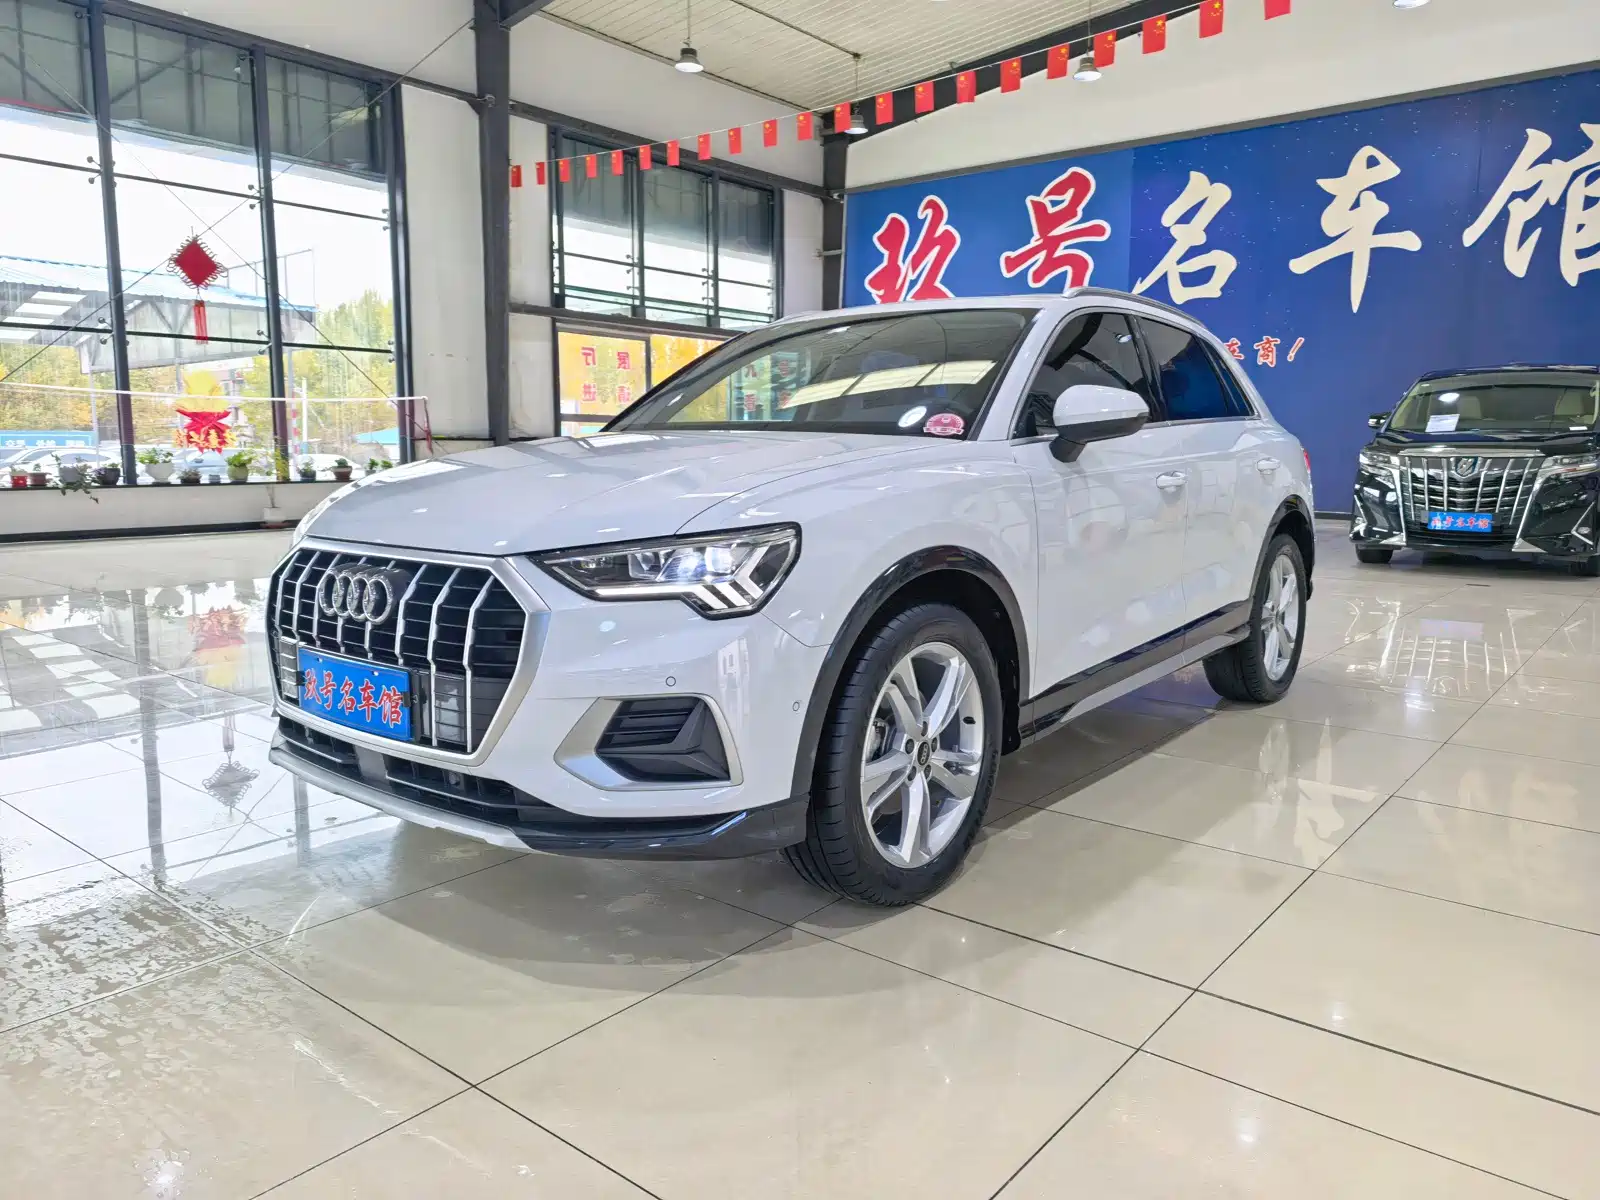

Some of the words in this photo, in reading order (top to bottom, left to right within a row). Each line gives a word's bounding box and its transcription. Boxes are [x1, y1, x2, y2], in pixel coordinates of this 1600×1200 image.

[864, 123, 1600, 312] 玖号名车馆
[304, 667, 404, 728] 玖号名车馆
